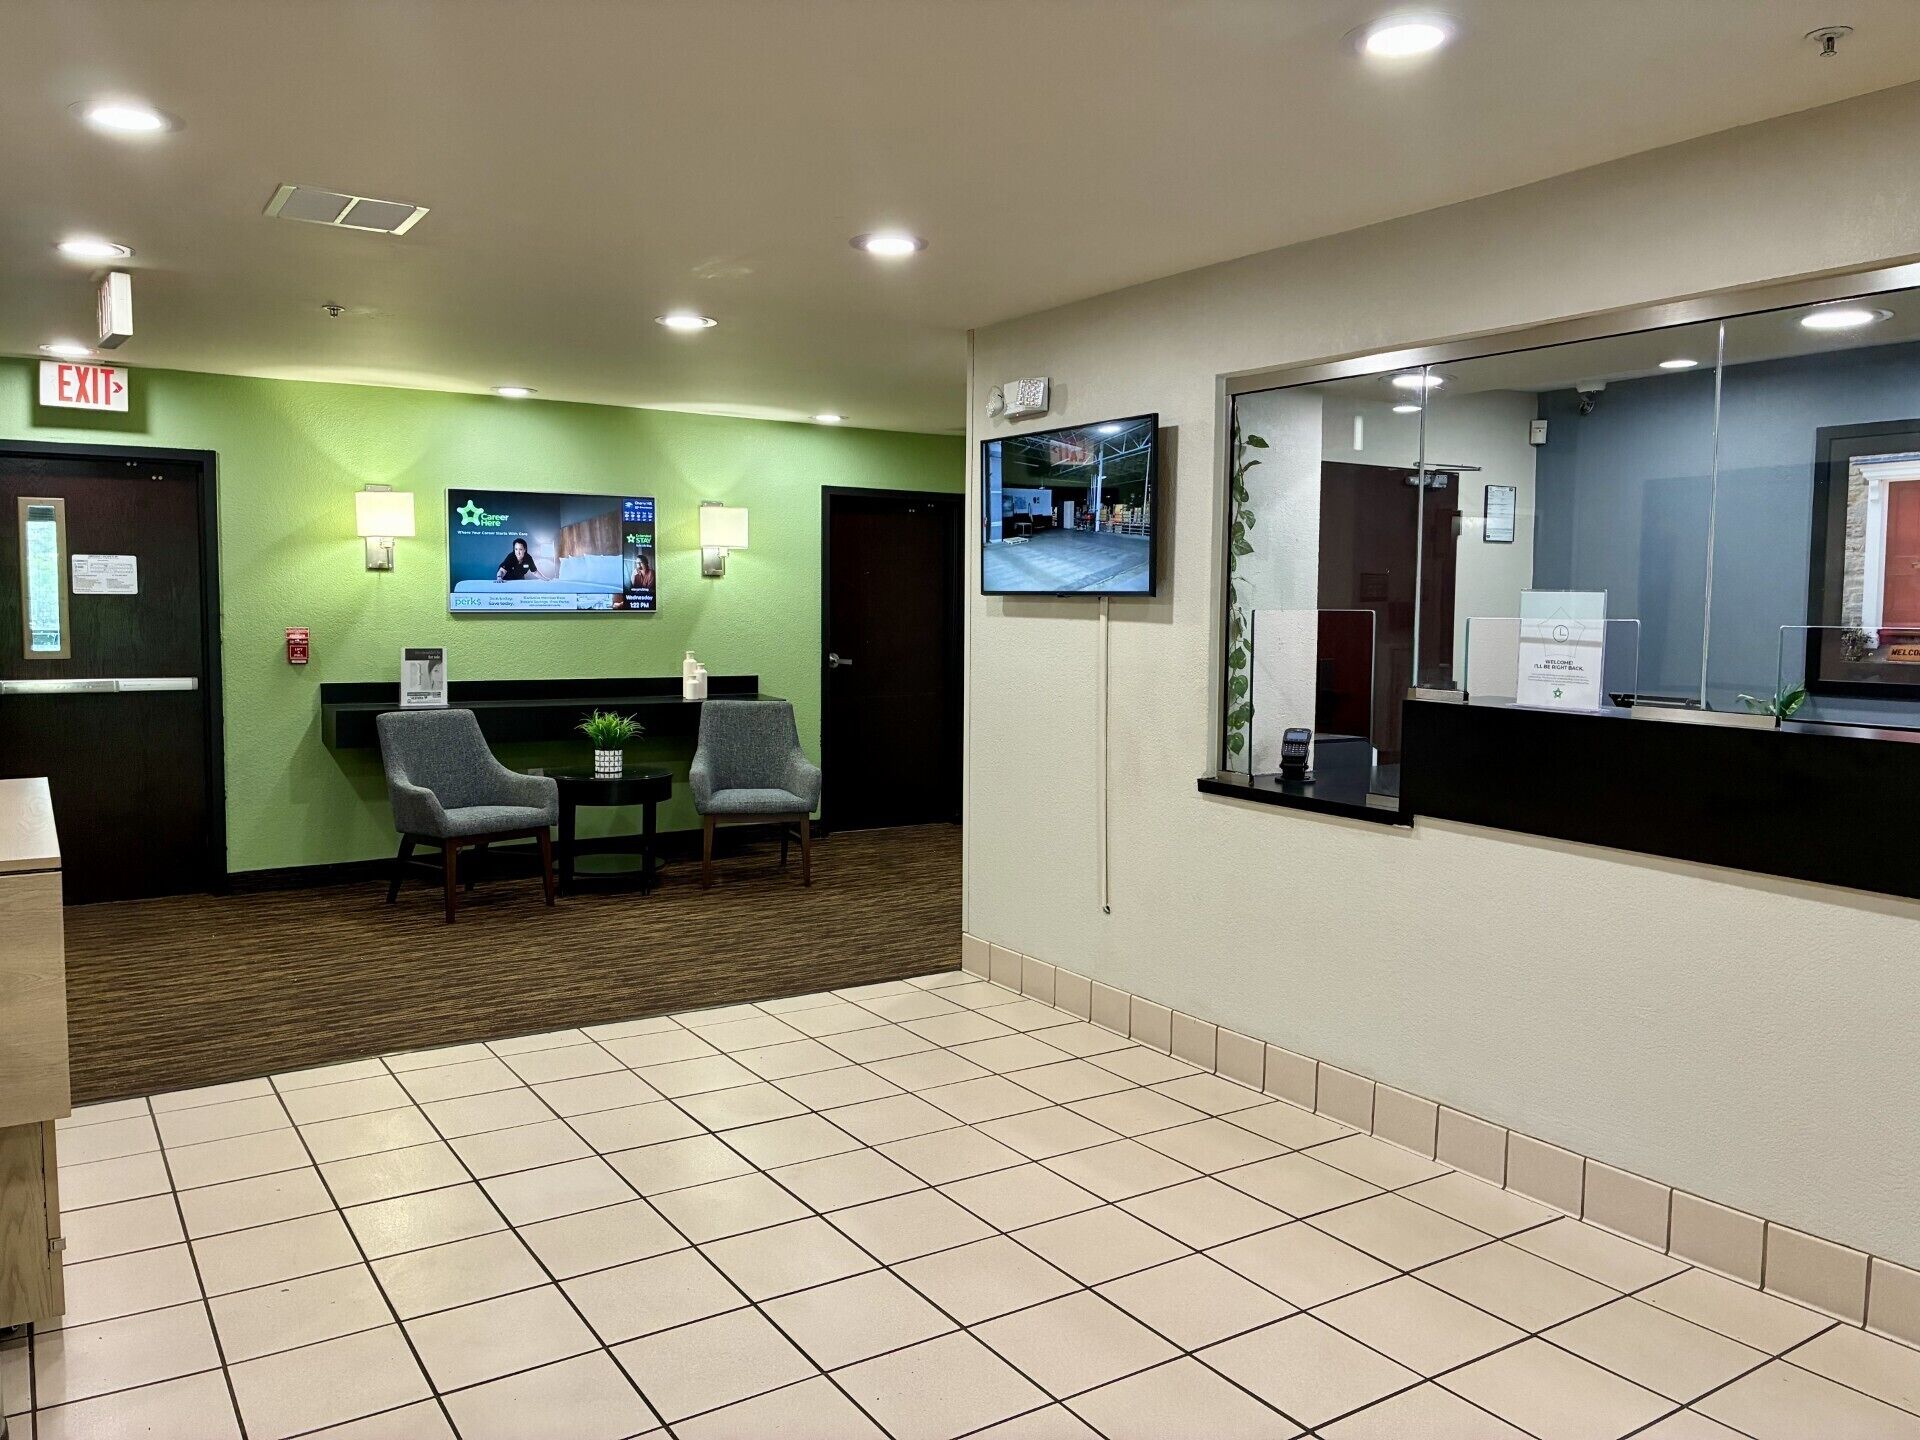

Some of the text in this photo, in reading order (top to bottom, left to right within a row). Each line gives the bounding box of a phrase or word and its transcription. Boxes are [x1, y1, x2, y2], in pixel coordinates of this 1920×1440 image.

[58, 364, 115, 406] EXIT
[481, 513, 509, 521] Career
[455, 597, 482, 607] perks
[1891, 648, 1920, 656] WELCO
